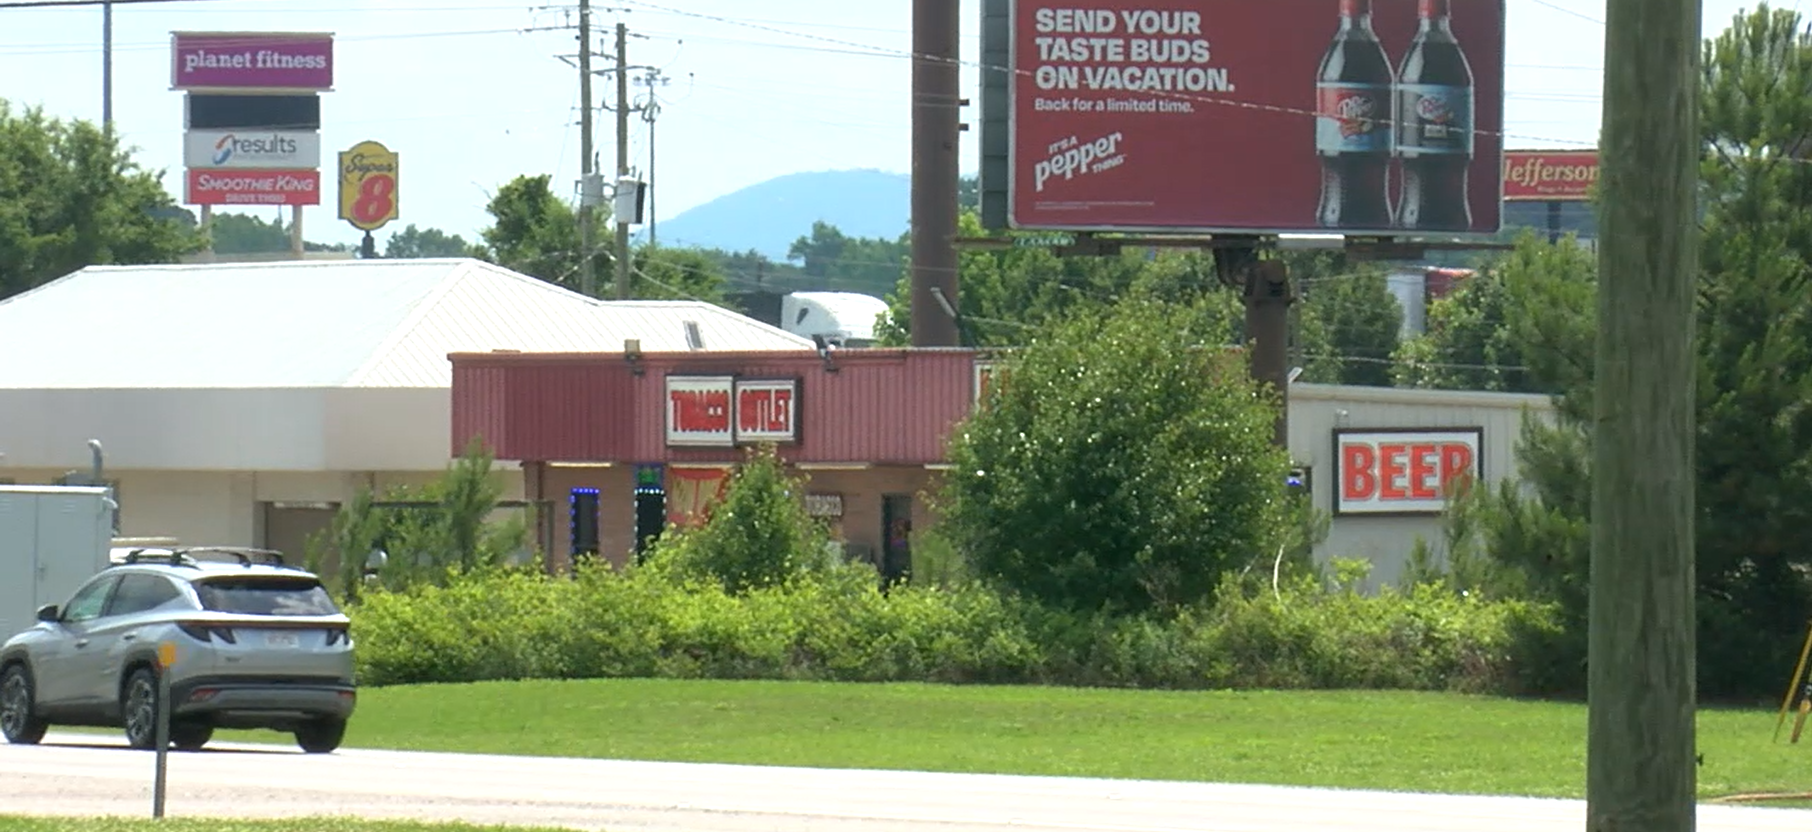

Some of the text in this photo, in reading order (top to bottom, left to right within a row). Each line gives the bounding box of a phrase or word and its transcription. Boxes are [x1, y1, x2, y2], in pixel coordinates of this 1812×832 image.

[1035, 8, 1201, 34] SEND YOUR
[185, 50, 327, 72] planet fitness
[1035, 37, 1210, 63] TASTE BUDS
[1036, 65, 1235, 92] ON VACATION.
[1035, 97, 1195, 113] Back for a limited time.
[233, 133, 296, 153] results
[1035, 131, 1122, 193] pepper
[275, 174, 315, 191] KING
[351, 174, 394, 223] 8
[740, 389, 791, 432] OUTLET
